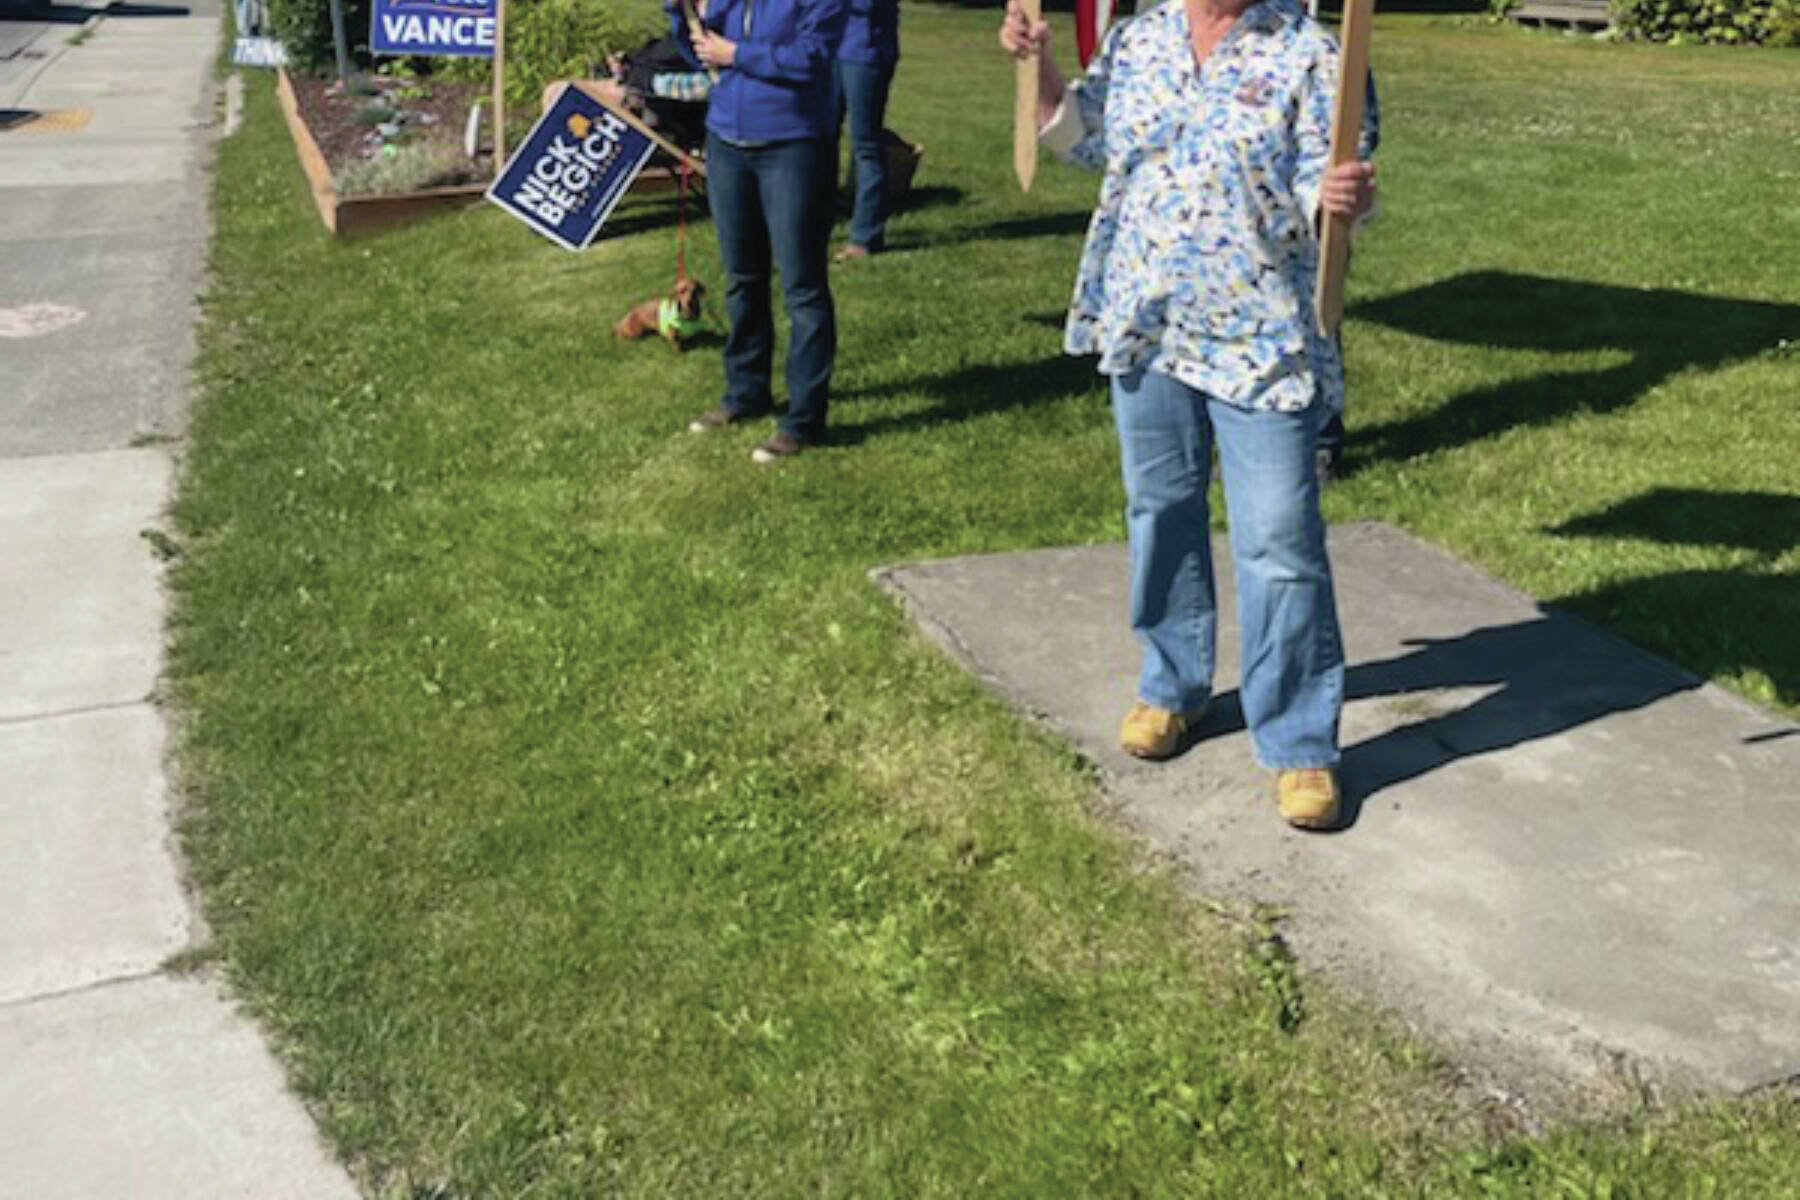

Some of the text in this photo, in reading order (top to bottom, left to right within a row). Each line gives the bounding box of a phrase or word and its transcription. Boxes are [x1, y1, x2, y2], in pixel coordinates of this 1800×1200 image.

[382, 14, 497, 46] VANCE
[513, 135, 579, 211] NICK
[536, 111, 628, 226] BEGICH
